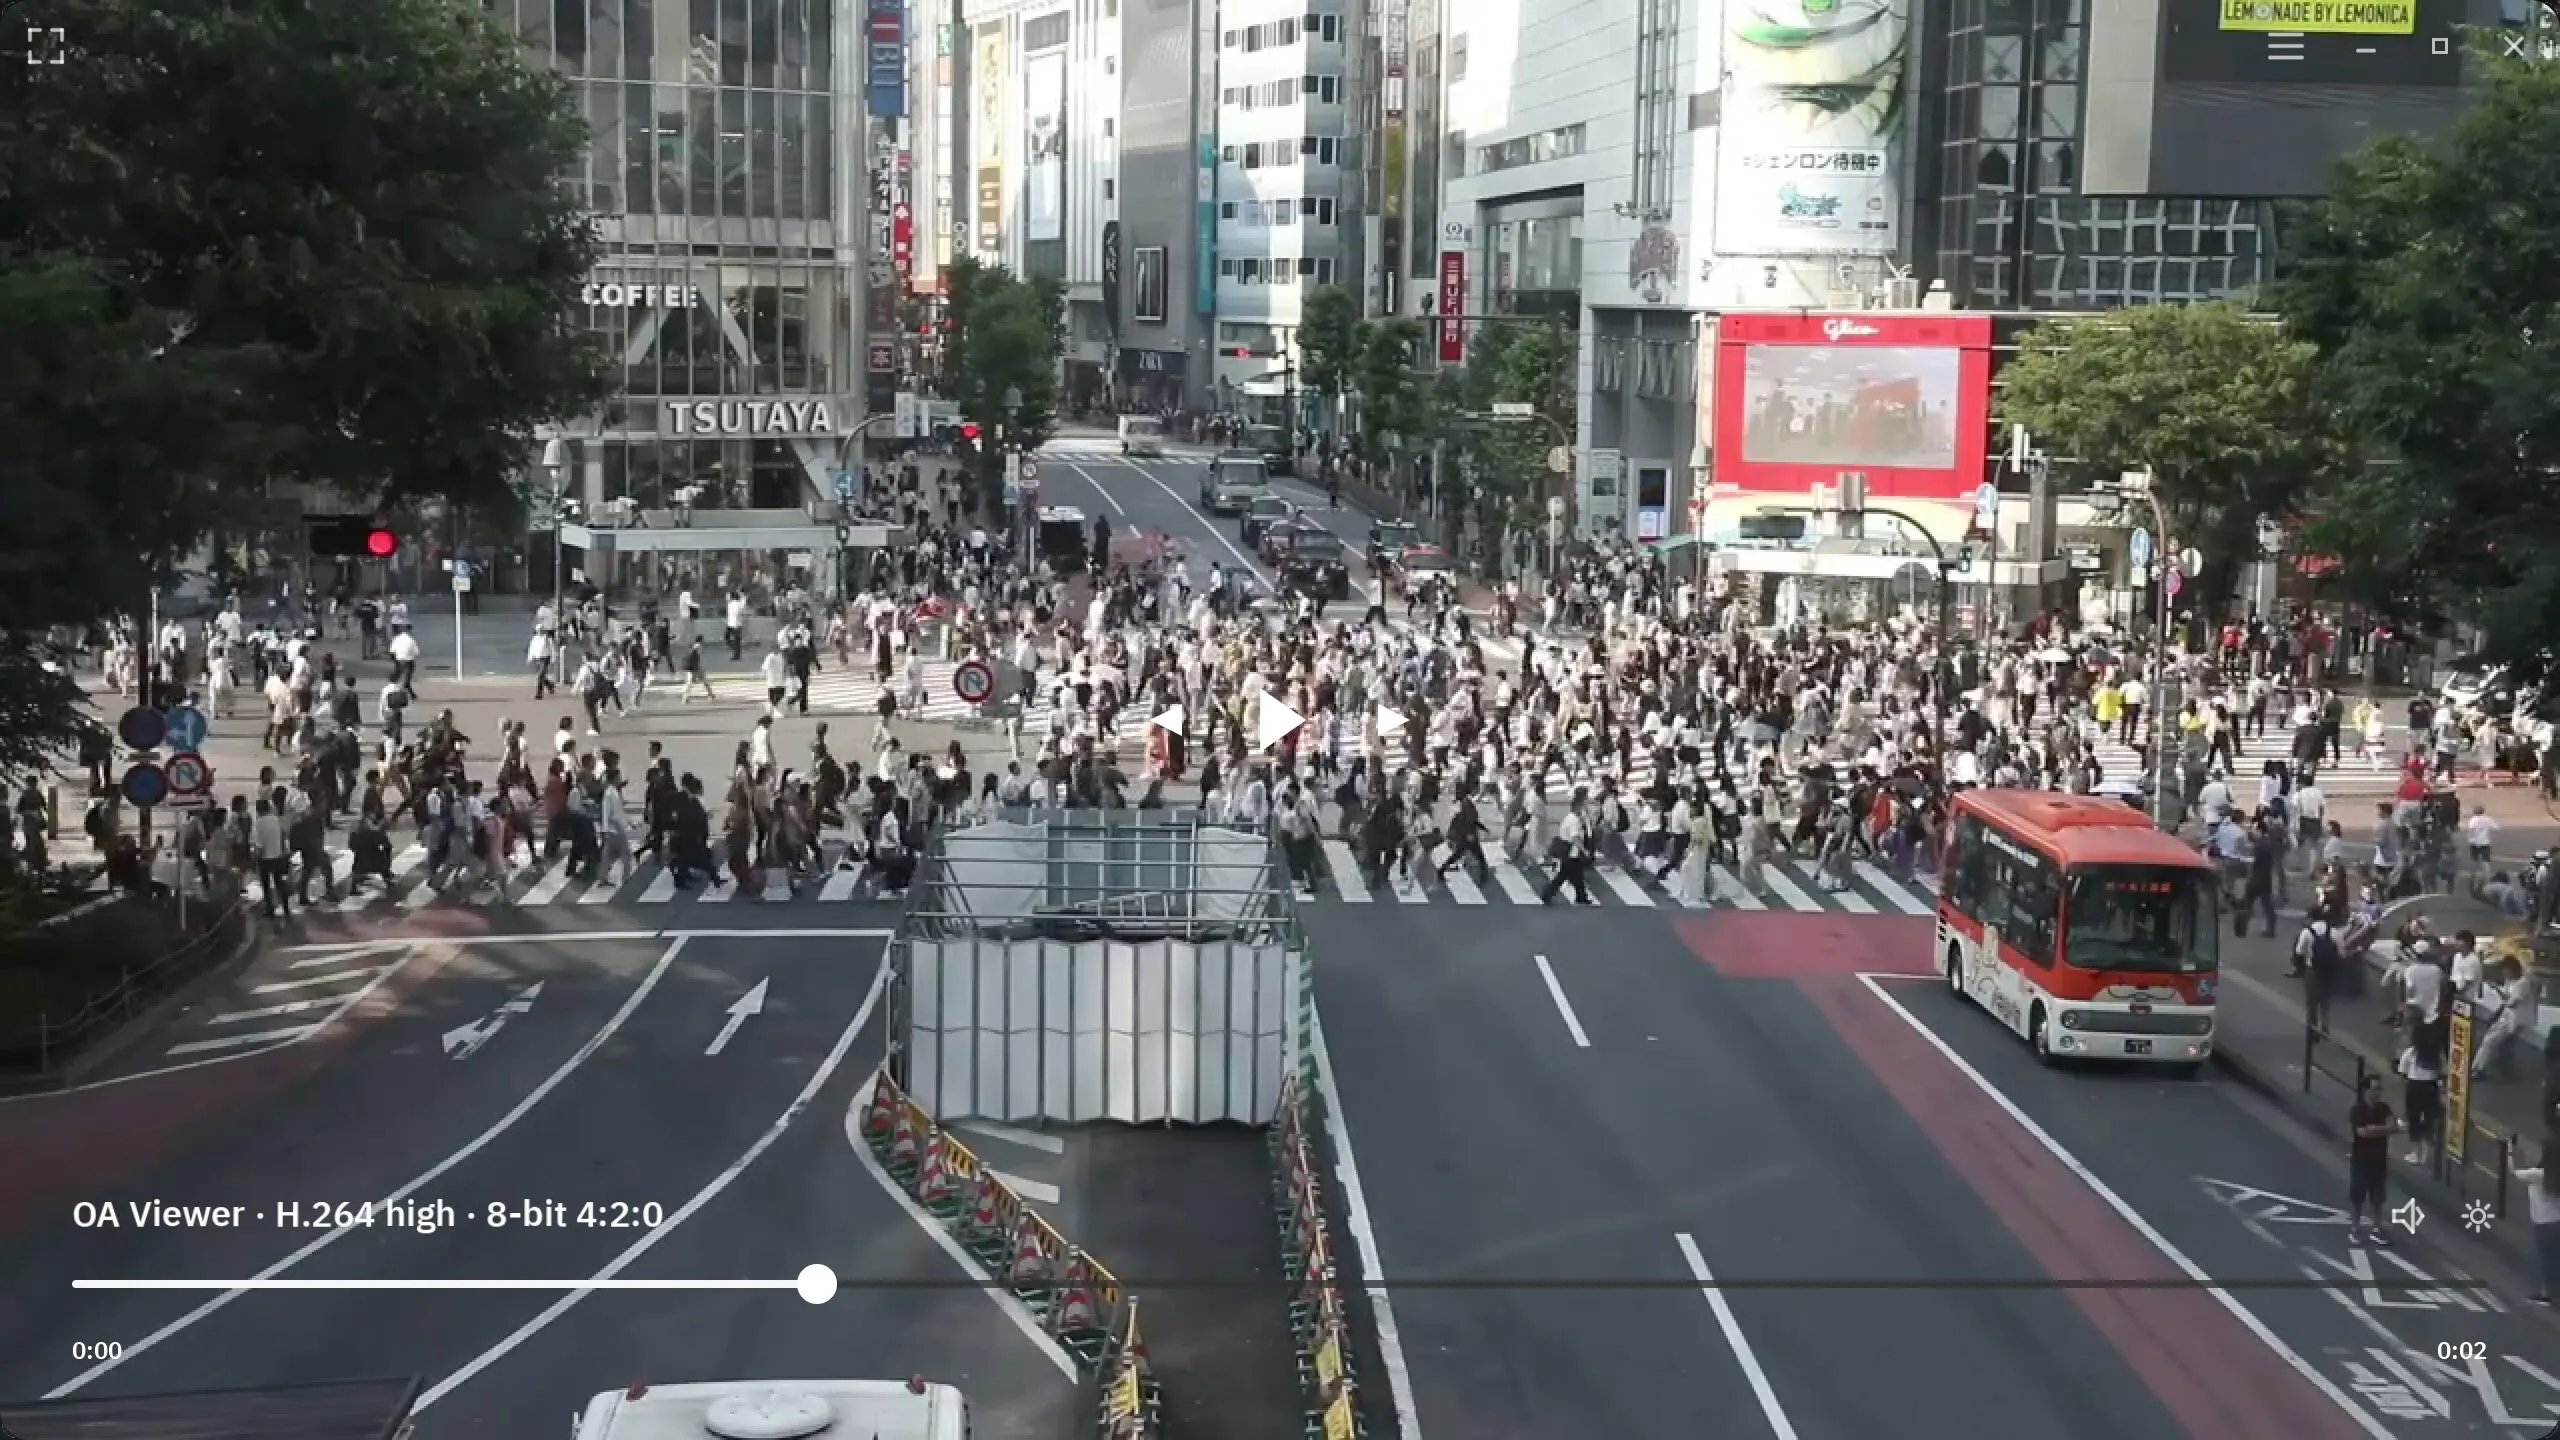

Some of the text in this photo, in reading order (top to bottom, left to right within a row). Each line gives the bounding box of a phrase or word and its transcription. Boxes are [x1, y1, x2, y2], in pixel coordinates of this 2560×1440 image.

[2313, 2, 2334, 22] BY
[2335, 3, 2409, 24] LEMONICA
[581, 283, 699, 308] COFFEE
[1823, 317, 1880, 343] Glico
[668, 401, 832, 433] TSUTAYA
